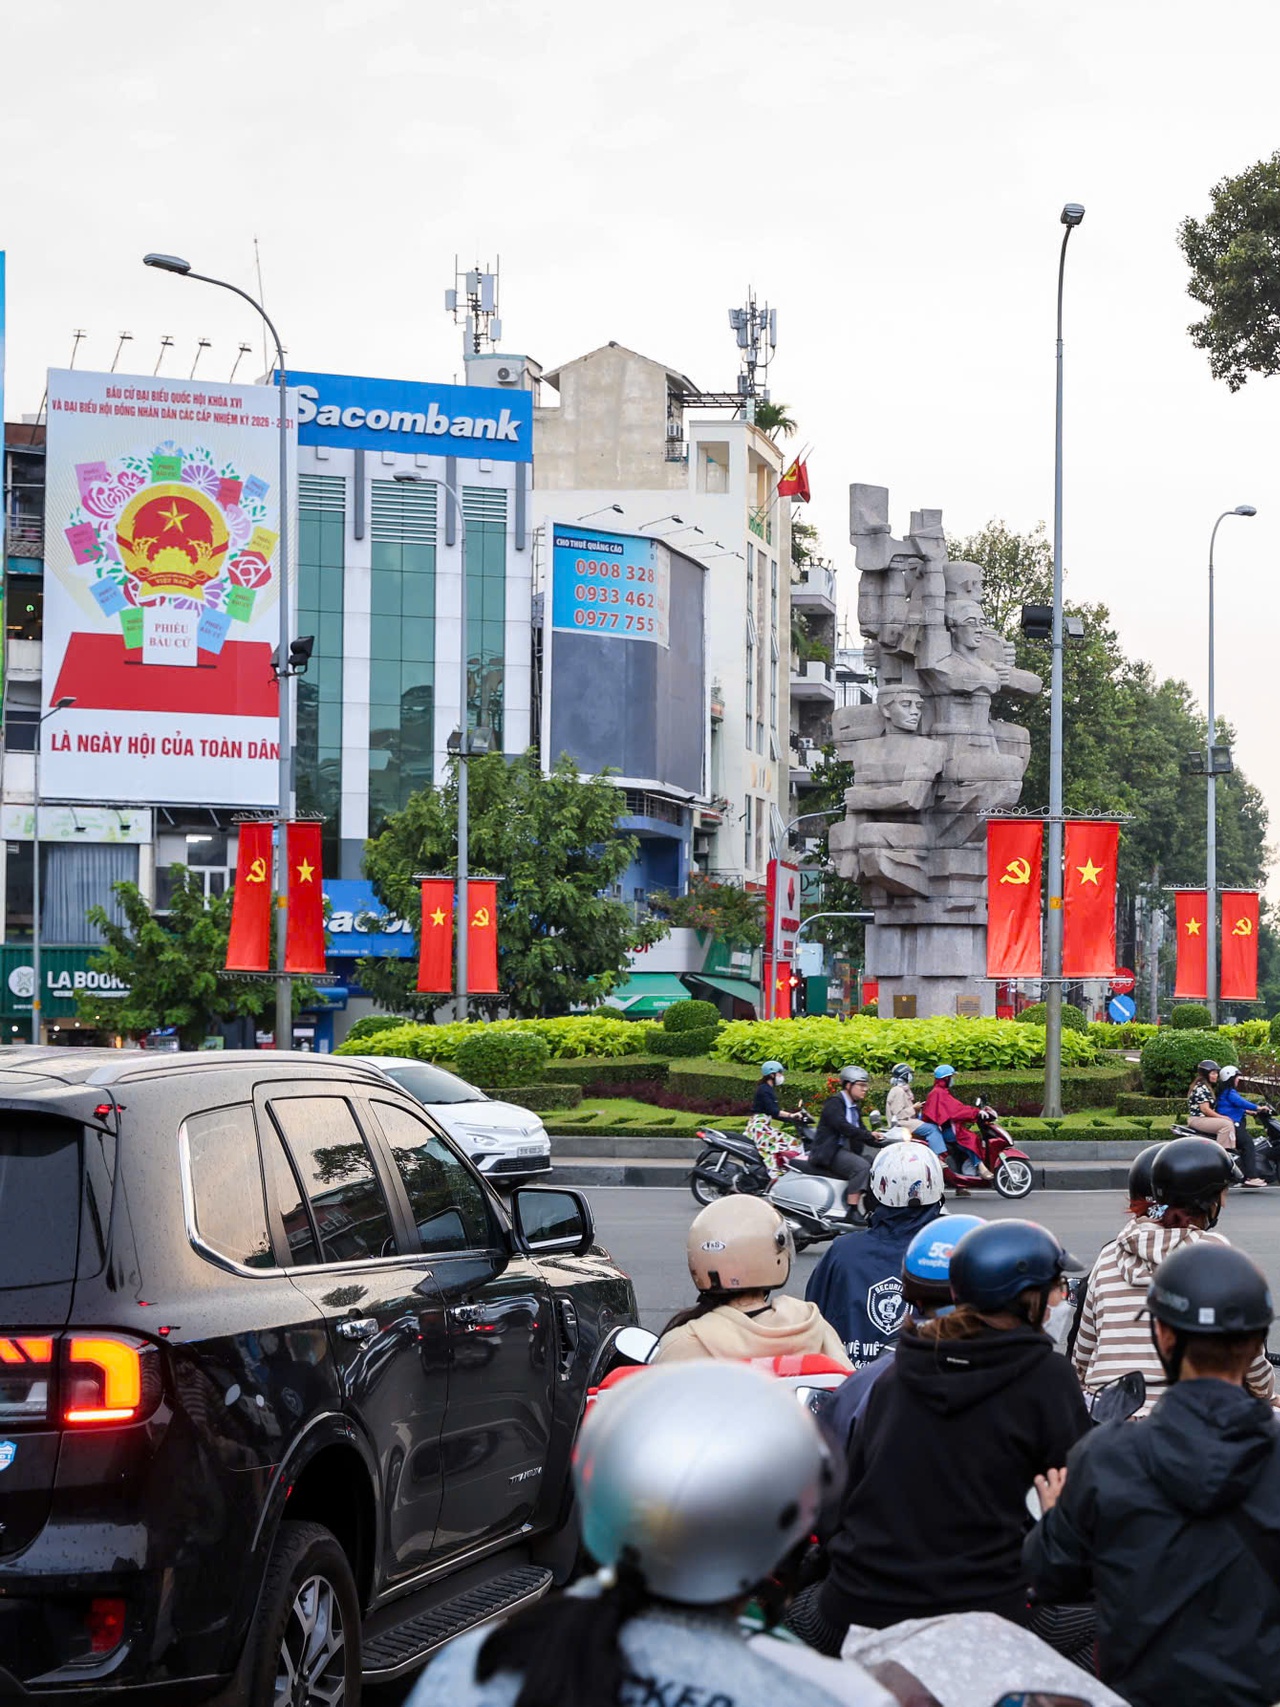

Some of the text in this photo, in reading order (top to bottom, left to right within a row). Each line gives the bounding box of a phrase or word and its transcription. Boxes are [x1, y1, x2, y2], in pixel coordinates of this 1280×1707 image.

[52, 398, 62, 410] VÀ
[179, 406, 195, 420] CÁC
[251, 416, 269, 427] 2026
[276, 418, 294, 429] 231
[230, 397, 242, 408] XVI
[298, 384, 522, 441] Sacombank
[556, 538, 569, 547] CHO
[576, 559, 655, 583] 0908 328
[575, 585, 654, 608] 0933 462
[575, 609, 654, 632] 0977 755
[51, 729, 280, 760] LÀ NGÀY HỘI CỦA TOÀN DÂN
[47, 971, 71, 988] LA
